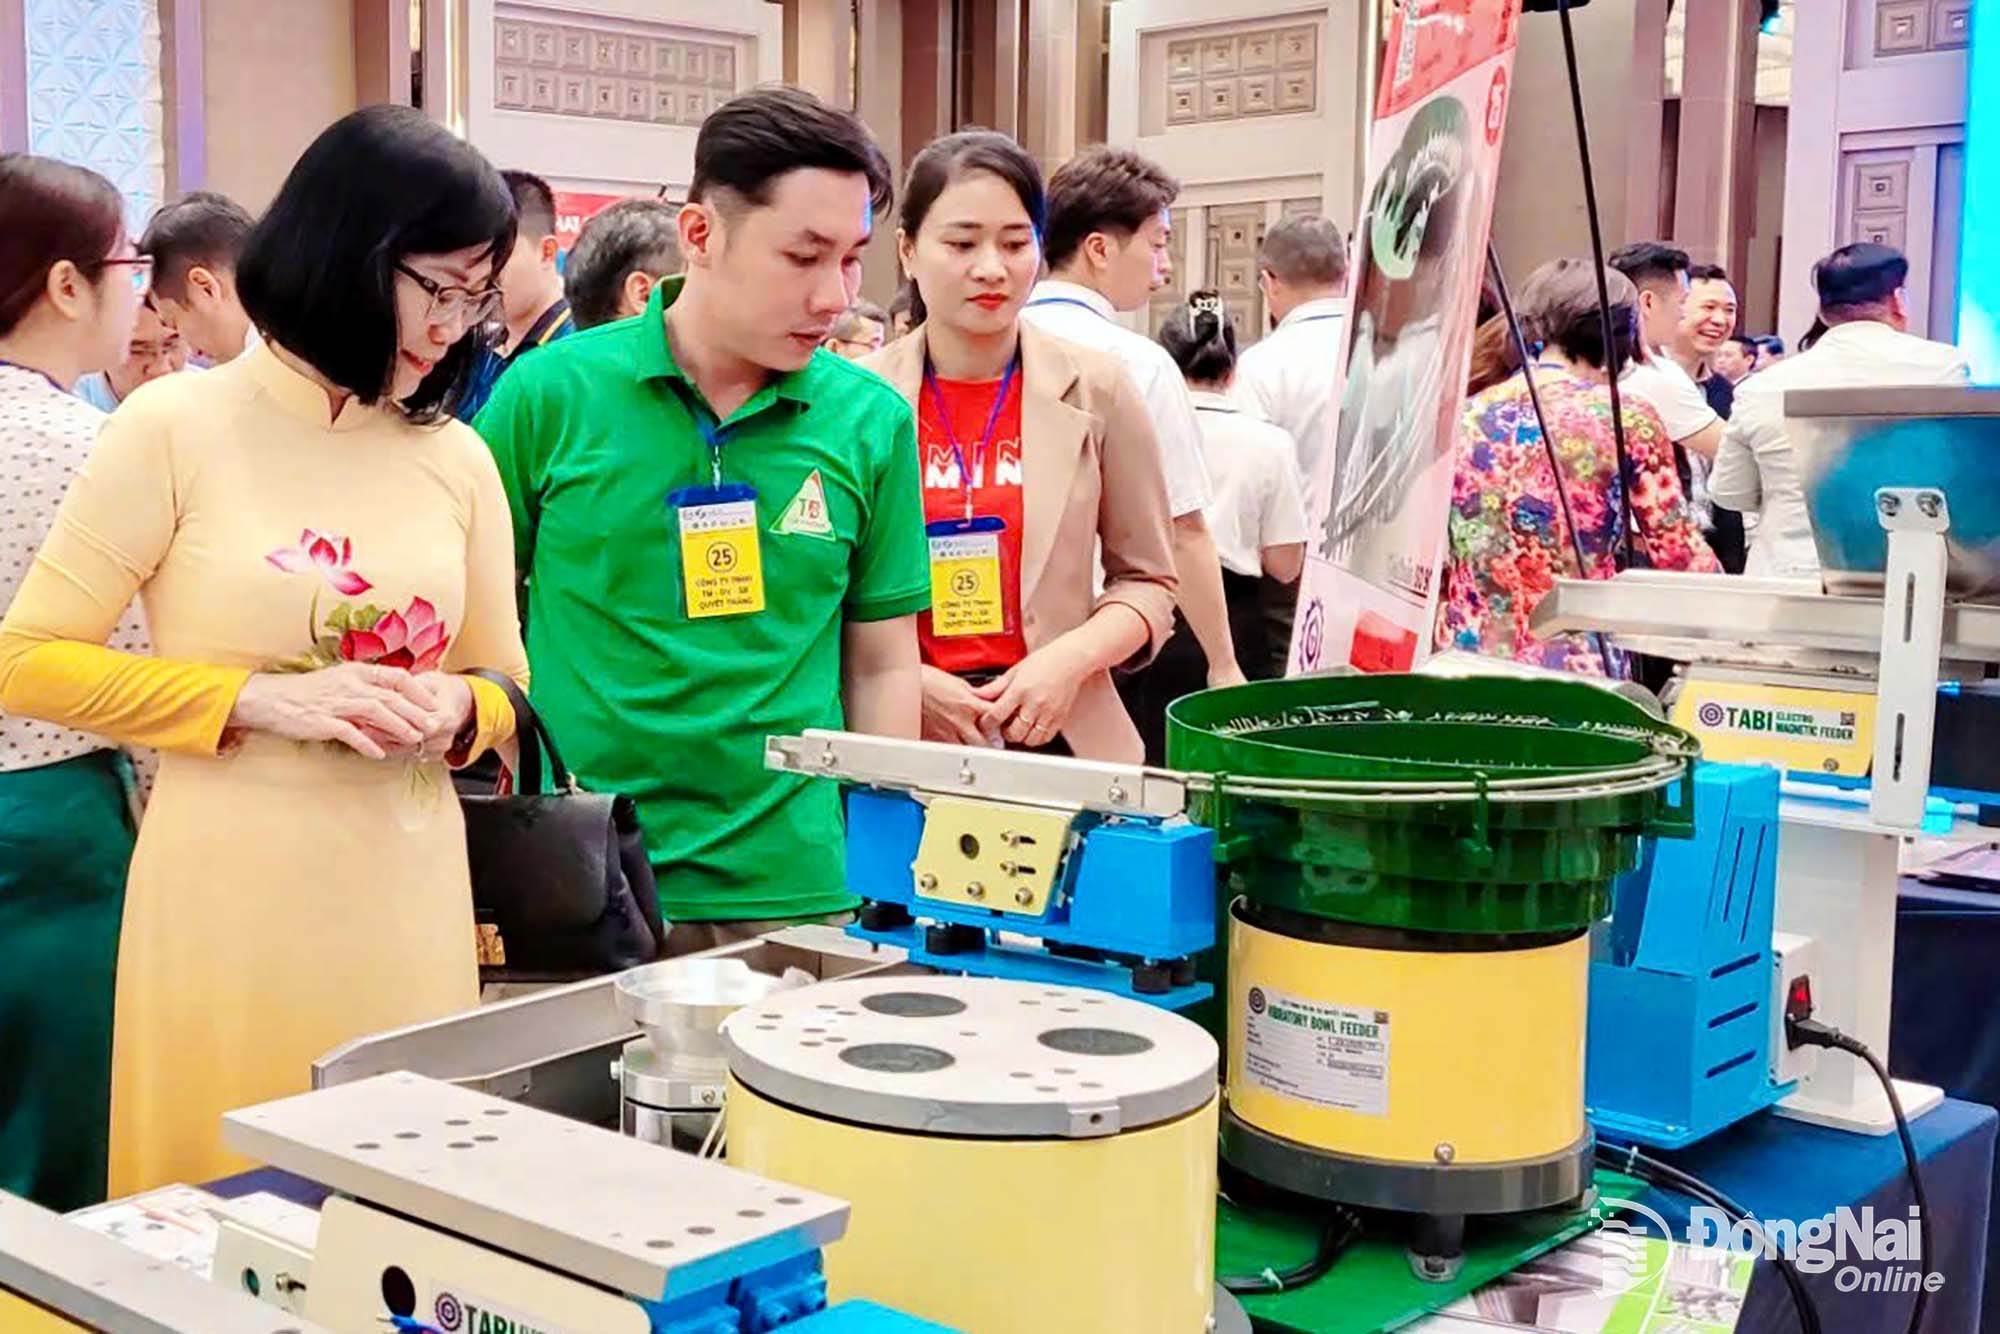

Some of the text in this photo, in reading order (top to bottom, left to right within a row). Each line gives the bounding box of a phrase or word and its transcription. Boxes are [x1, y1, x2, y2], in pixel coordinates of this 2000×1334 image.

[711, 548, 732, 566] 25
[957, 574, 975, 591] 25
[1726, 707, 1814, 731] TABI ELECTRO
[1776, 722, 1854, 740] MAGNETIC FEEDER
[1268, 1004, 1308, 1027] VIBRATORY
[1311, 1016, 1337, 1034] BOWL
[1340, 1020, 1379, 1038] FEEDER
